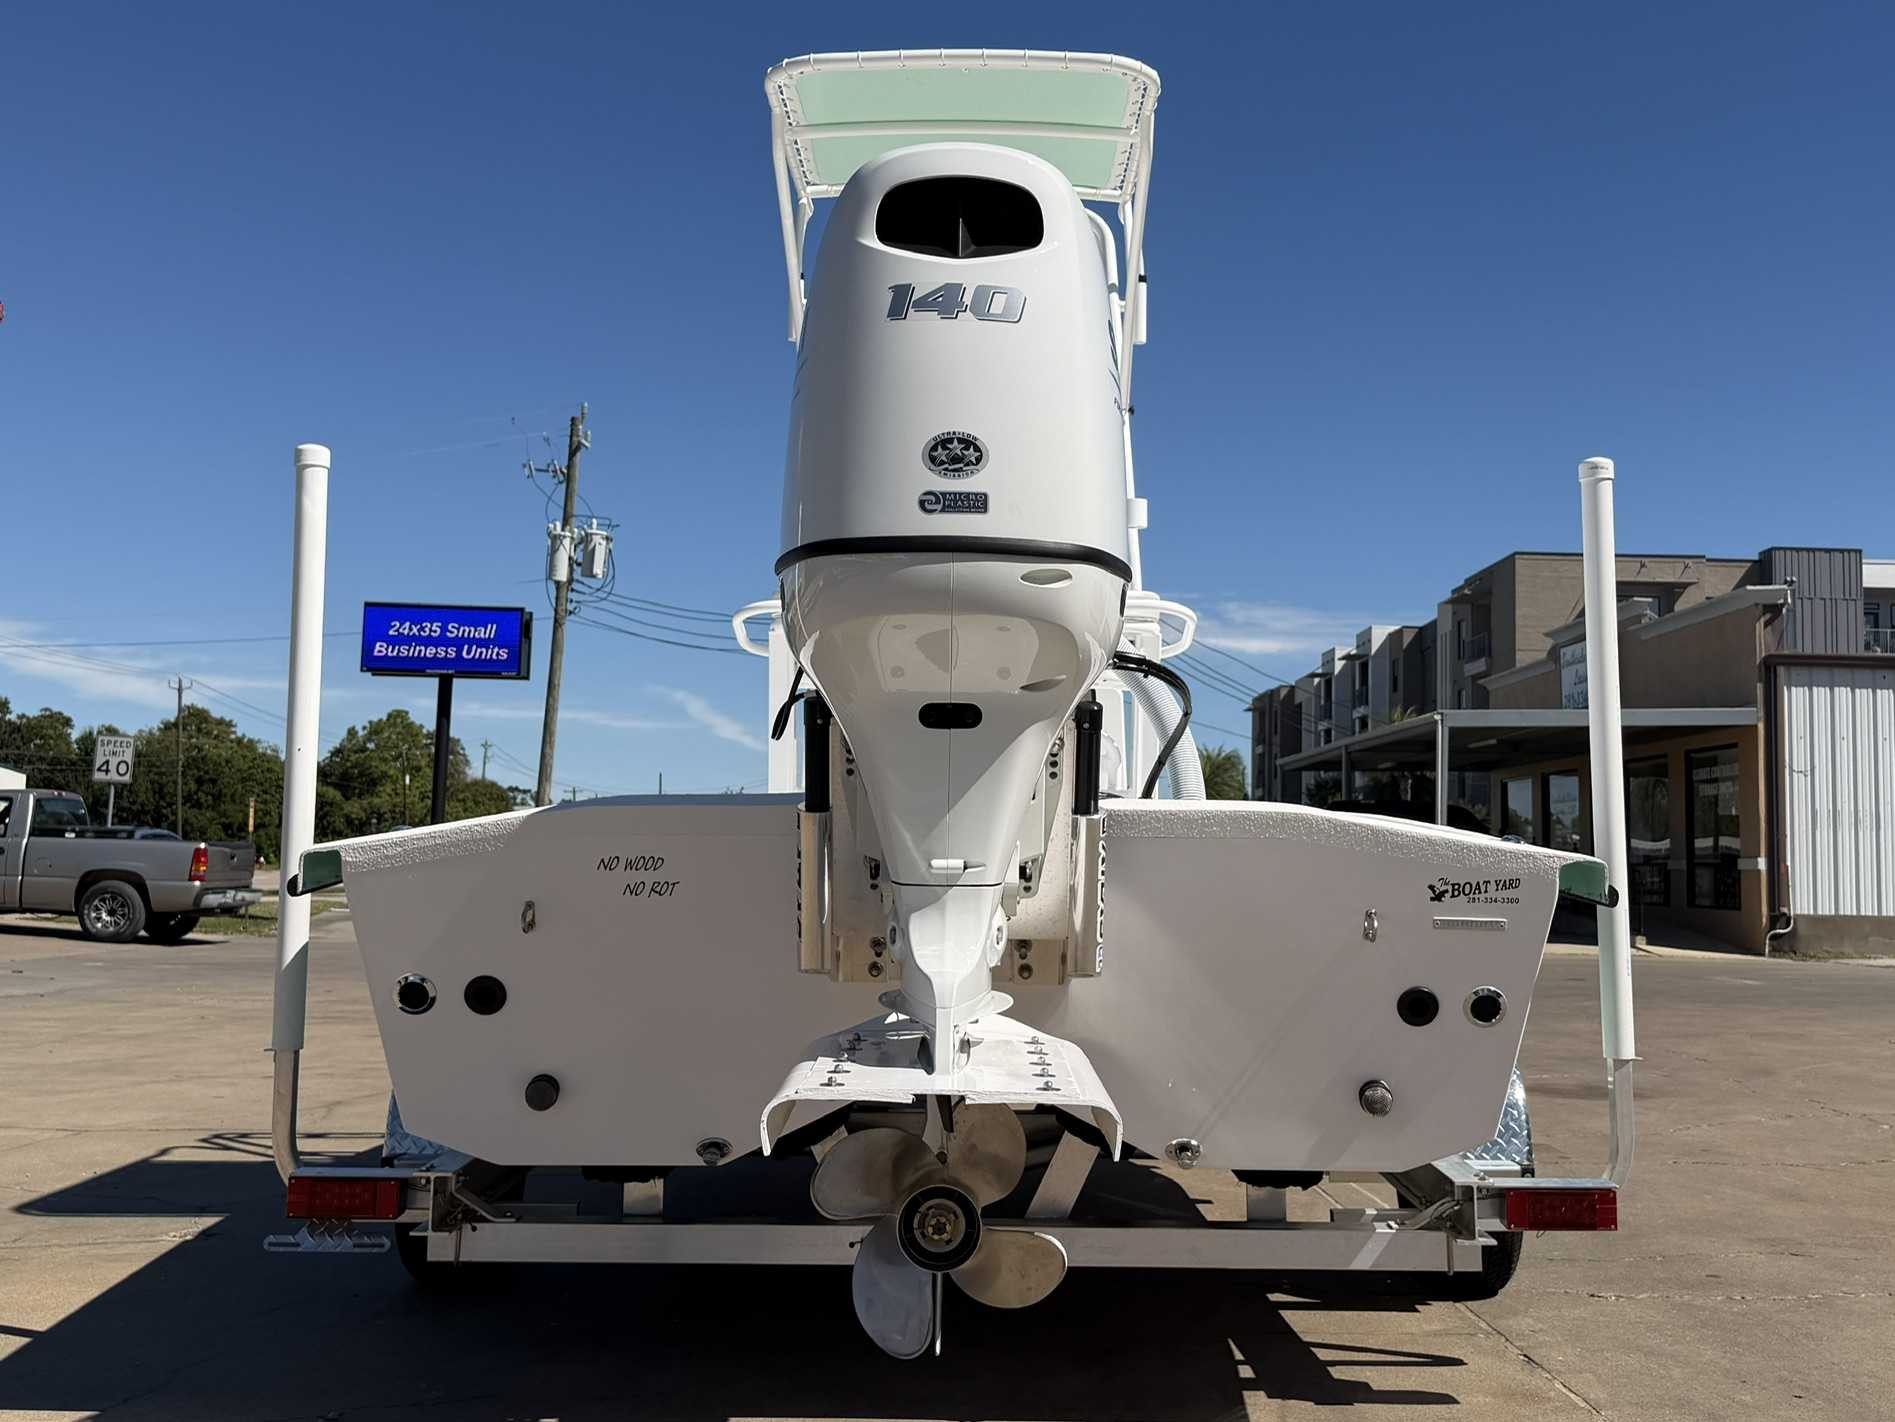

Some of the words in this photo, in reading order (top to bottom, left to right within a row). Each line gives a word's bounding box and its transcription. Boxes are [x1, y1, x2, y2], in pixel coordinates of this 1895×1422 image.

[887, 283, 1027, 324] 140
[945, 500, 985, 508] PLASTIC
[946, 493, 985, 501] MICRO
[388, 621, 442, 638] 24x35
[446, 622, 497, 639] Small
[373, 642, 457, 659] Business
[462, 644, 509, 660] Units
[100, 739, 132, 749] SPEED
[103, 749, 127, 757] LIMIT
[96, 759, 130, 777] 40
[597, 855, 620, 871] NO
[624, 855, 665, 872] WOOD
[622, 881, 646, 896] NO
[648, 881, 680, 898] ROT
[1438, 877, 1451, 888] The
[1449, 880, 1491, 899] BOAT
[1494, 878, 1521, 891] YARD
[1466, 896, 1520, 905] 281-334-3300
